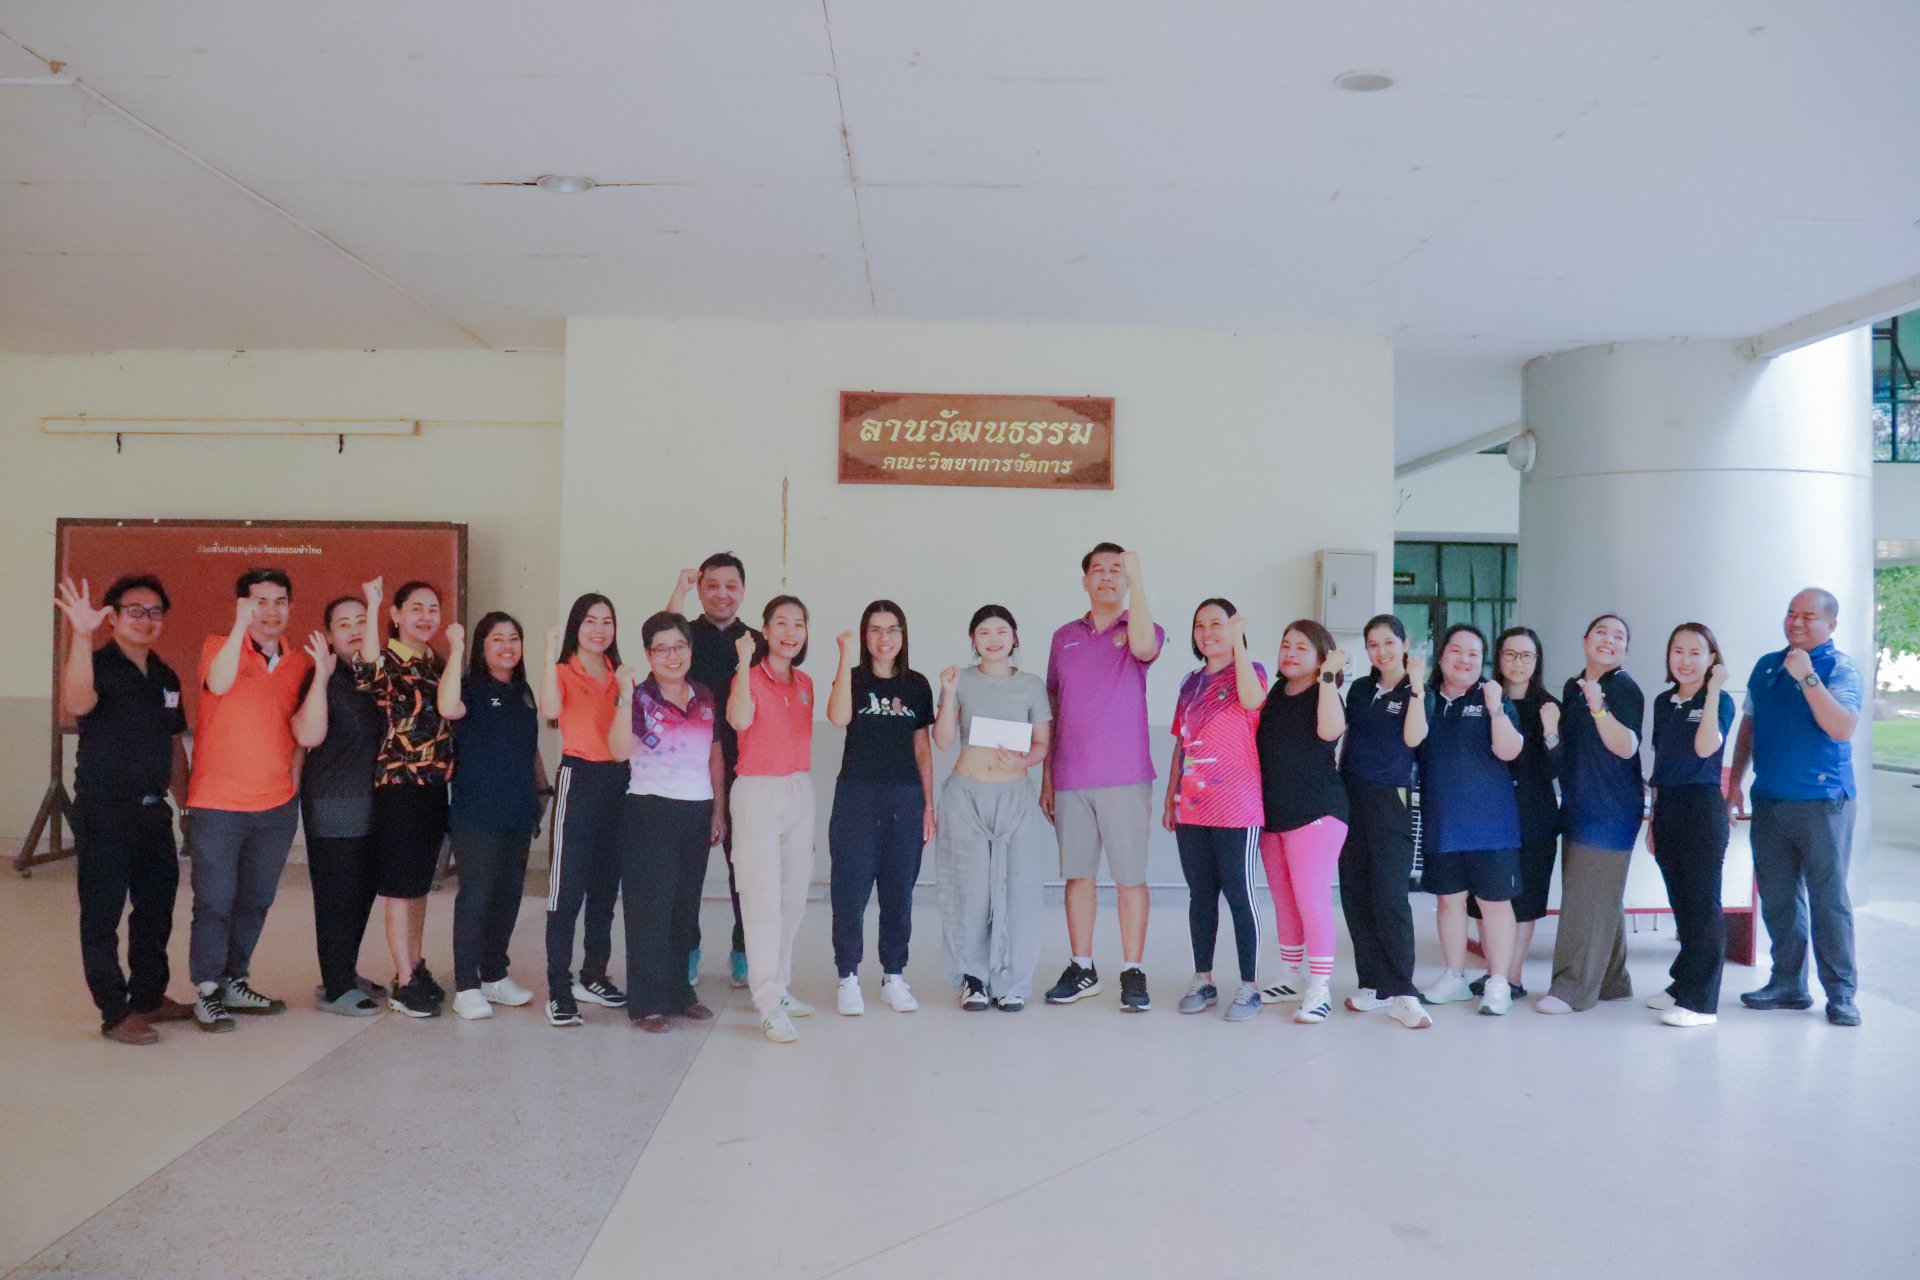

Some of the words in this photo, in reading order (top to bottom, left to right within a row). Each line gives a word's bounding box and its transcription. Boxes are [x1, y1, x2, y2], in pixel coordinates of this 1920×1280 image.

[859, 409, 1094, 445] ลานวัฒนธรรม
[882, 452, 1073, 474] คณะวิทยาการจัดการ
